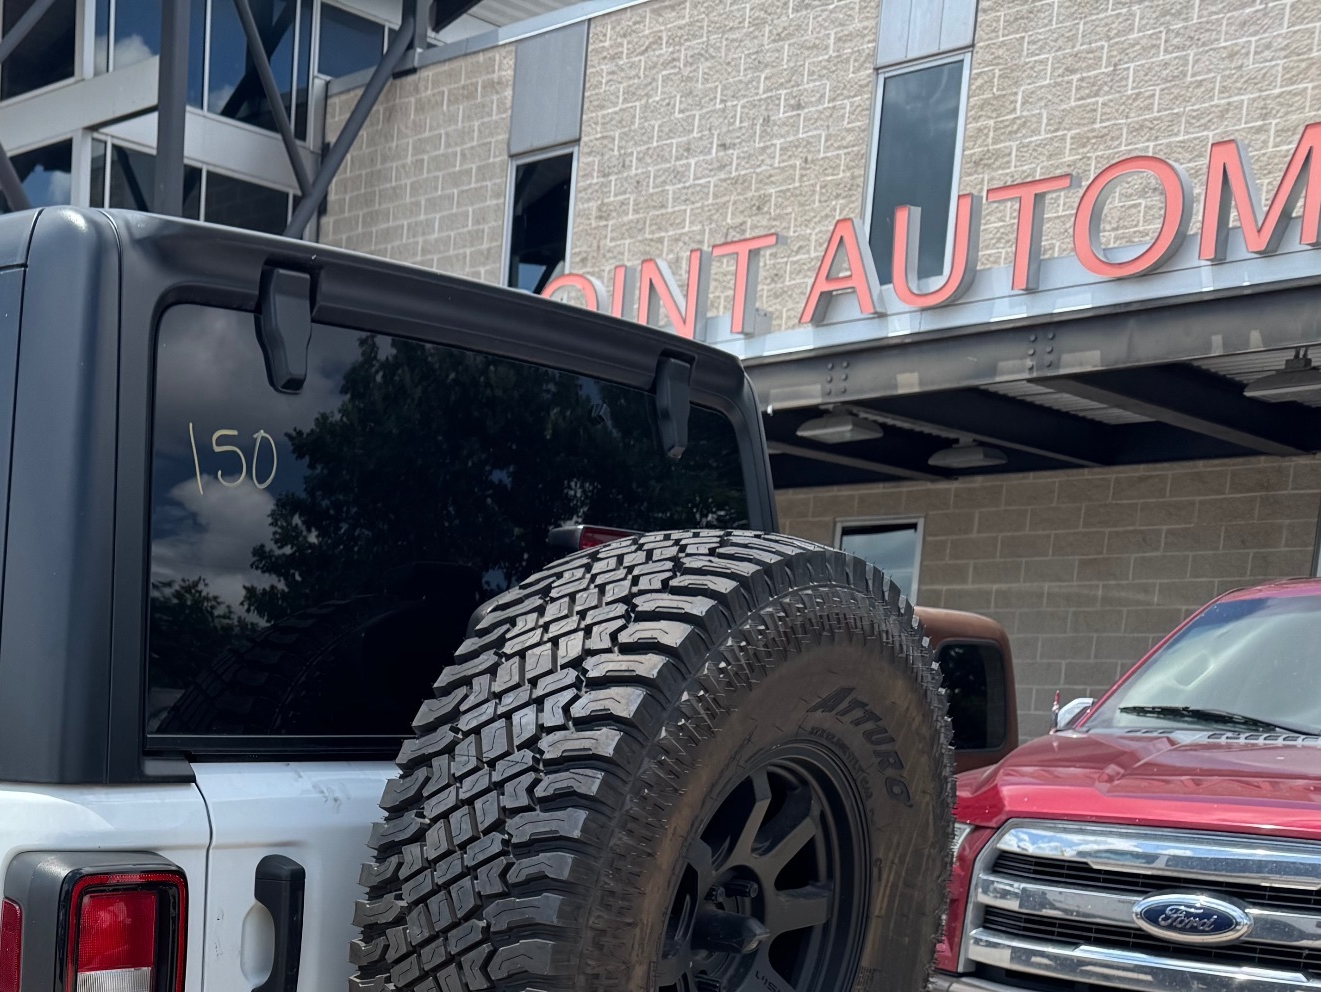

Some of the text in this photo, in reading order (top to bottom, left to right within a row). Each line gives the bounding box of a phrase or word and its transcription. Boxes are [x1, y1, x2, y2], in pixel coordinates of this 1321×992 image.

[799, 122, 1321, 324] AUTOM
[188, 422, 277, 495] 150
[806, 687, 913, 808] ATTURO
[1158, 905, 1218, 931] Ford
